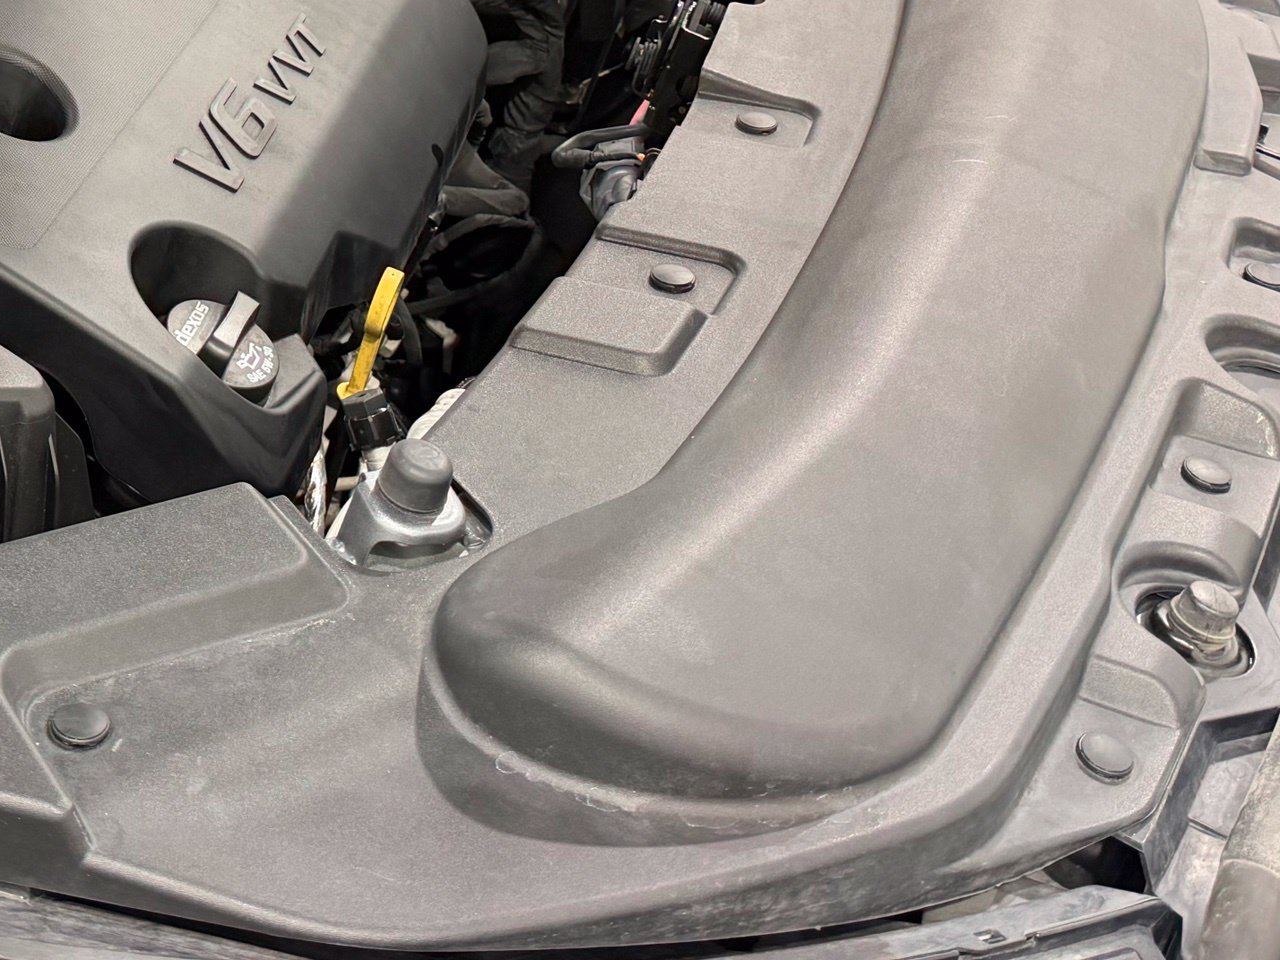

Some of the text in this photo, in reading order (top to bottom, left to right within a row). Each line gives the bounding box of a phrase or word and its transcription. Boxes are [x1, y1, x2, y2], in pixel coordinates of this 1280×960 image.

[172, 12, 327, 194] V6 VVT
[174, 301, 210, 346] dexos
[246, 369, 267, 383] SAE
